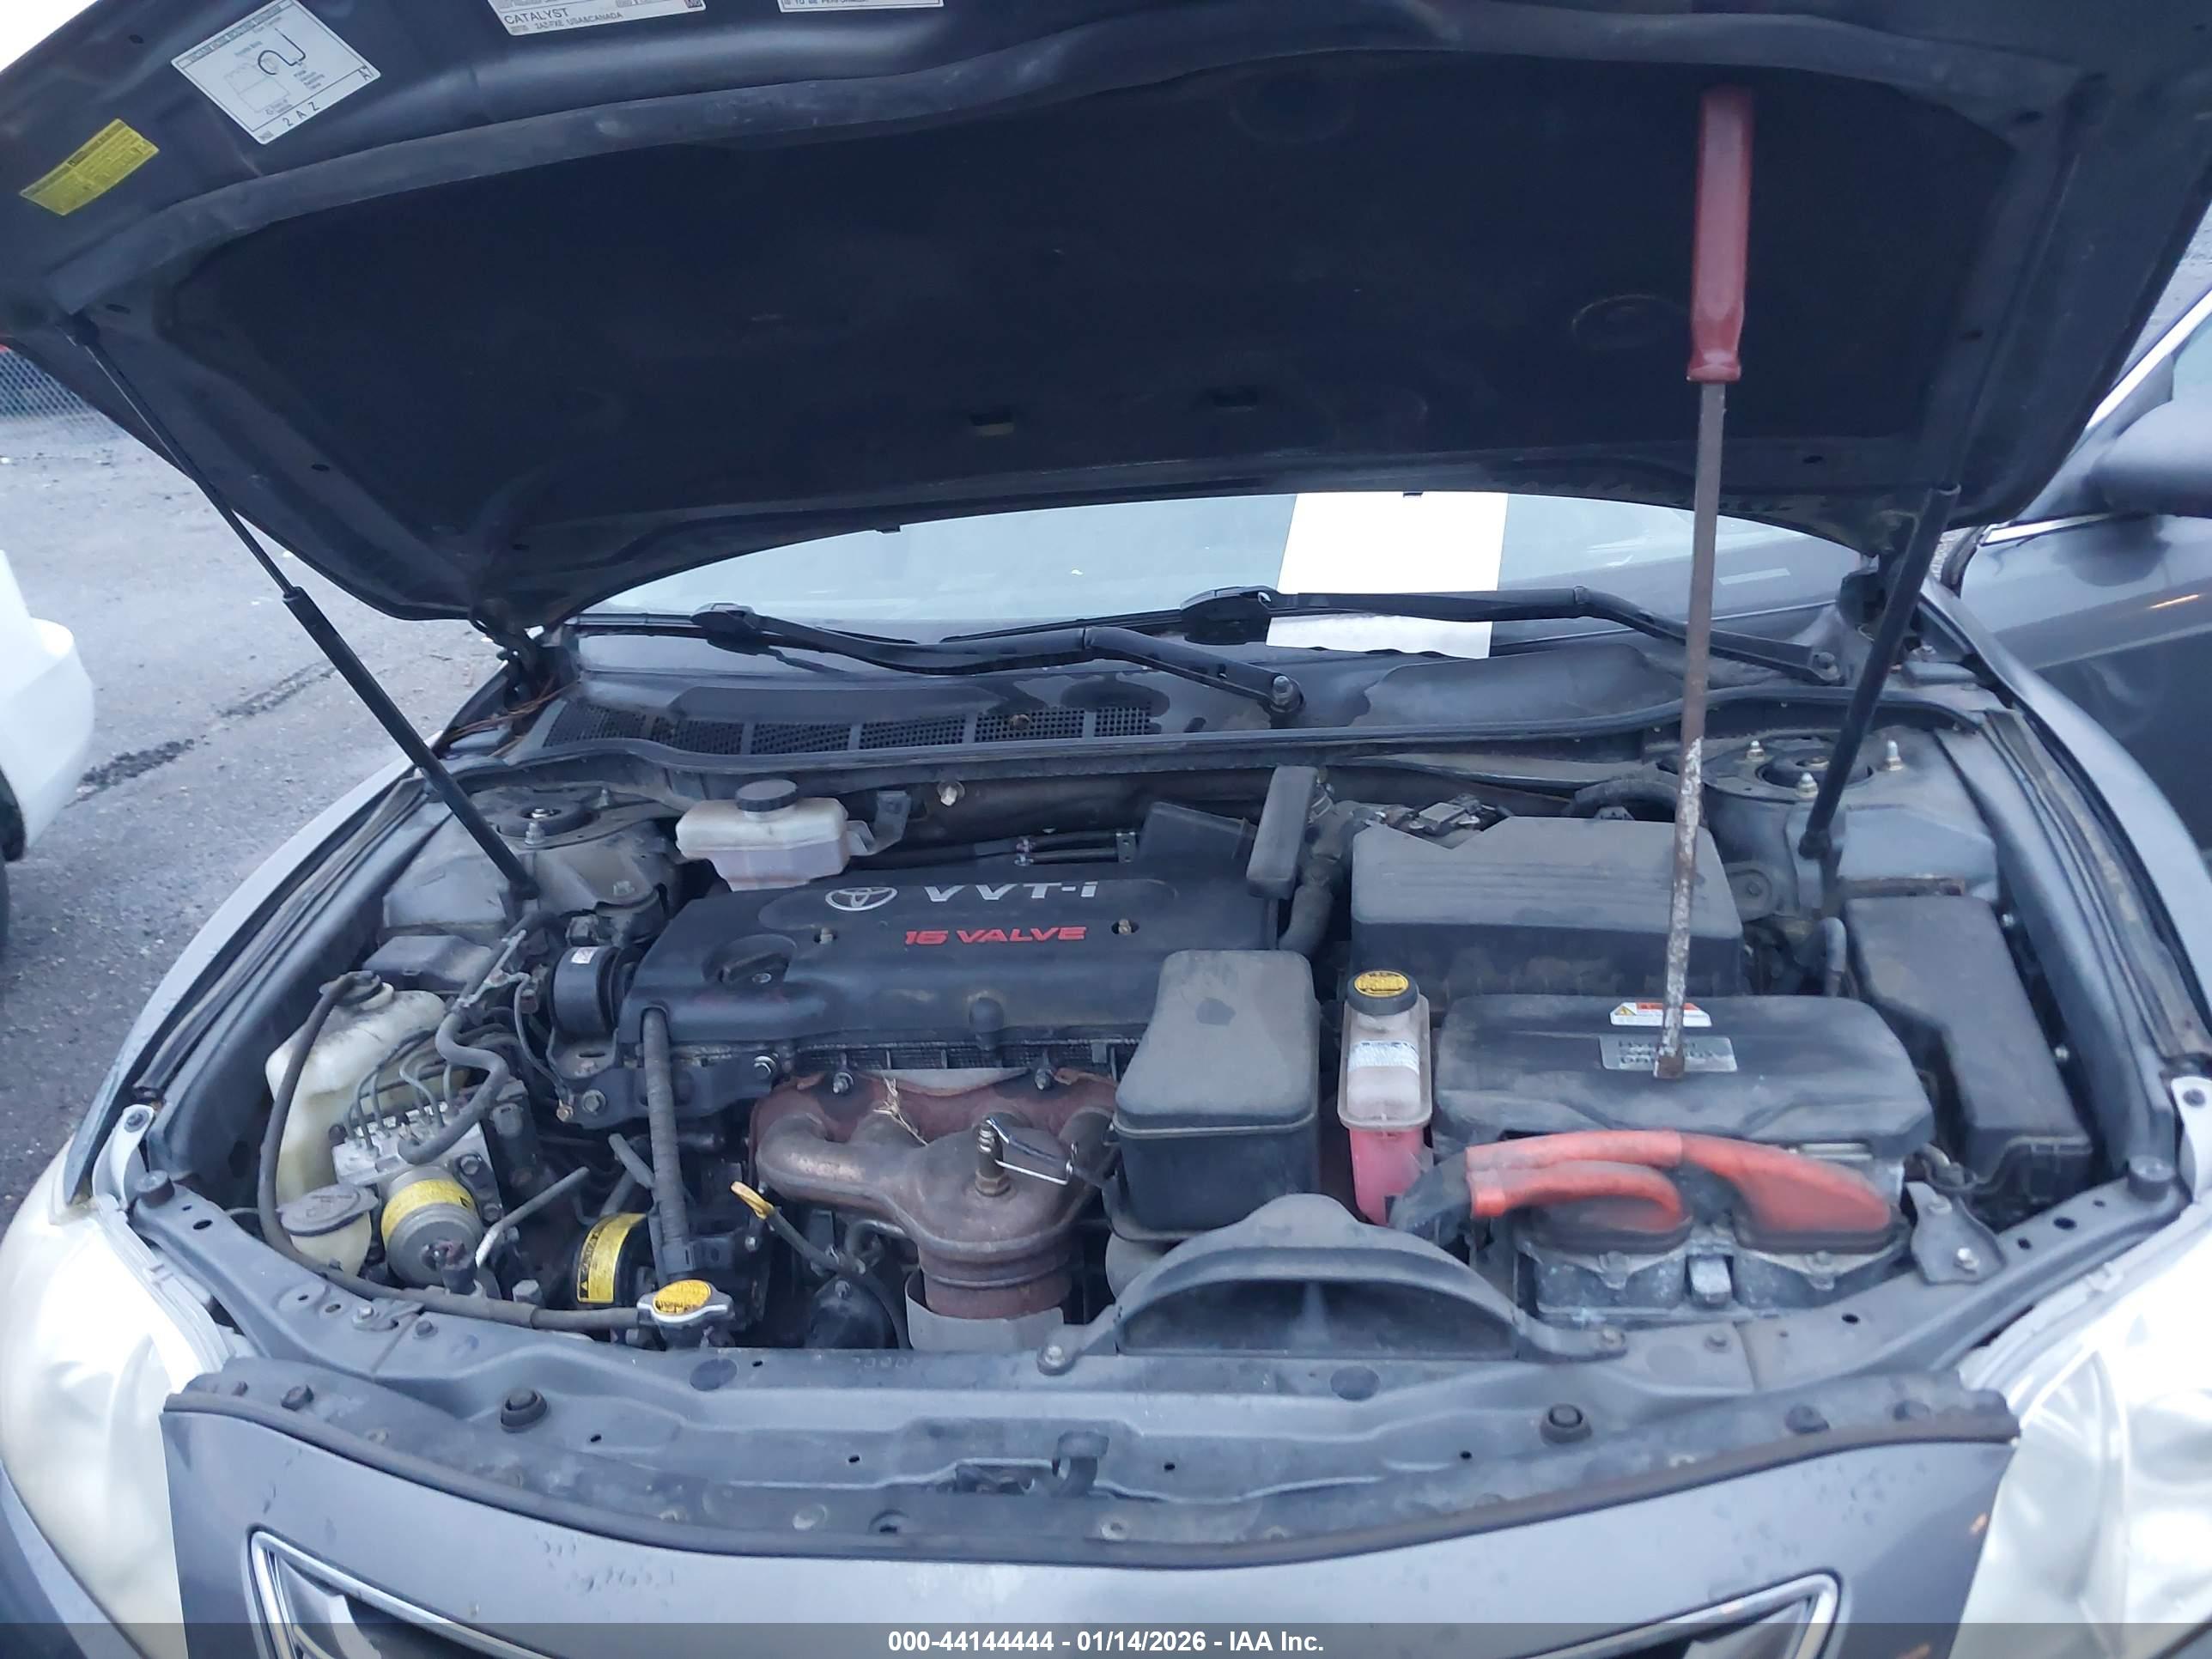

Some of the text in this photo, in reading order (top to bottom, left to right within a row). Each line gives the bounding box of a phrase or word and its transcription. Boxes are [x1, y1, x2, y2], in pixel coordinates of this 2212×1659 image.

[504, 8, 568, 25] CATALYST
[924, 881, 1098, 902] VVT-i
[905, 927, 1087, 945] 16 VALVE
